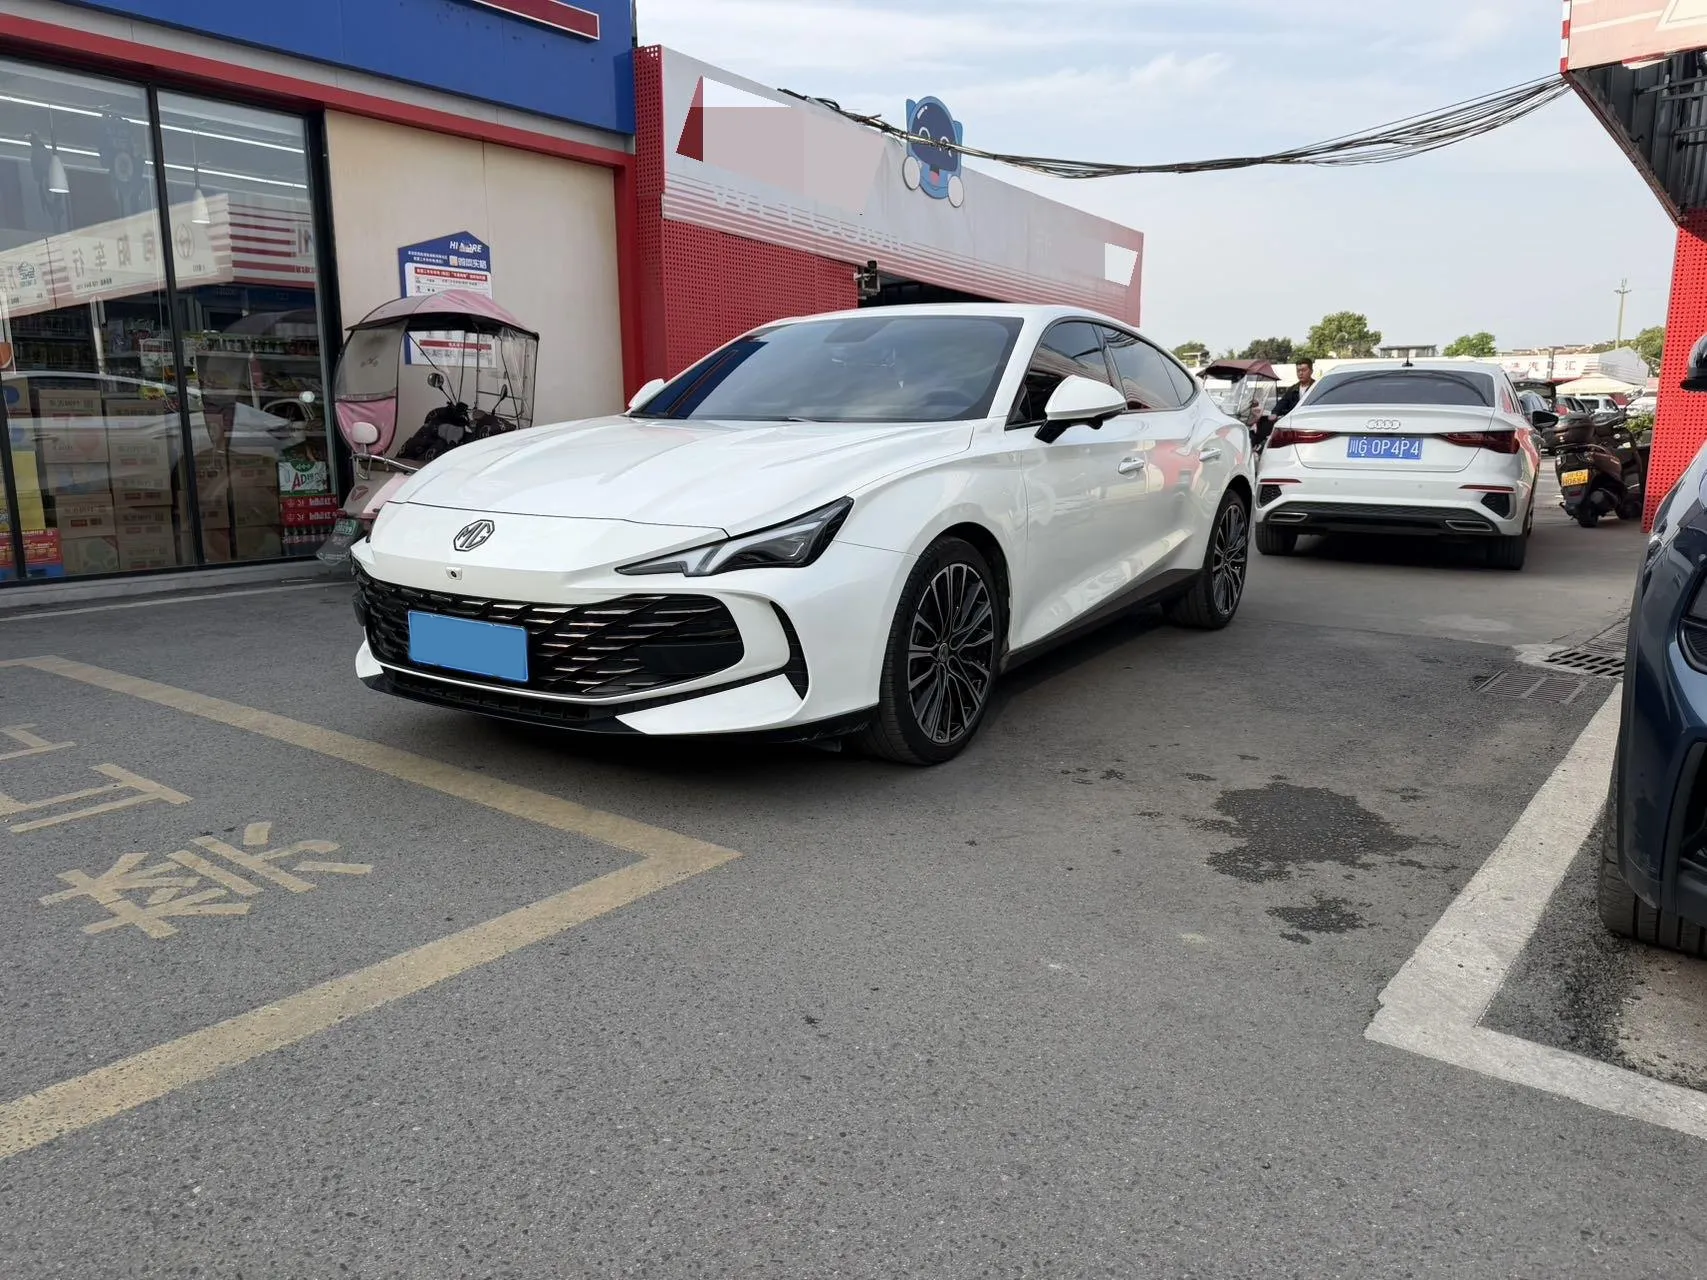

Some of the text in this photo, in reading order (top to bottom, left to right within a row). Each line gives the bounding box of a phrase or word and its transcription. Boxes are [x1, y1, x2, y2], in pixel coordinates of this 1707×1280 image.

[459, 242, 482, 253] RE
[455, 520, 493, 550] MG
[0, 724, 373, 938] 禁止
